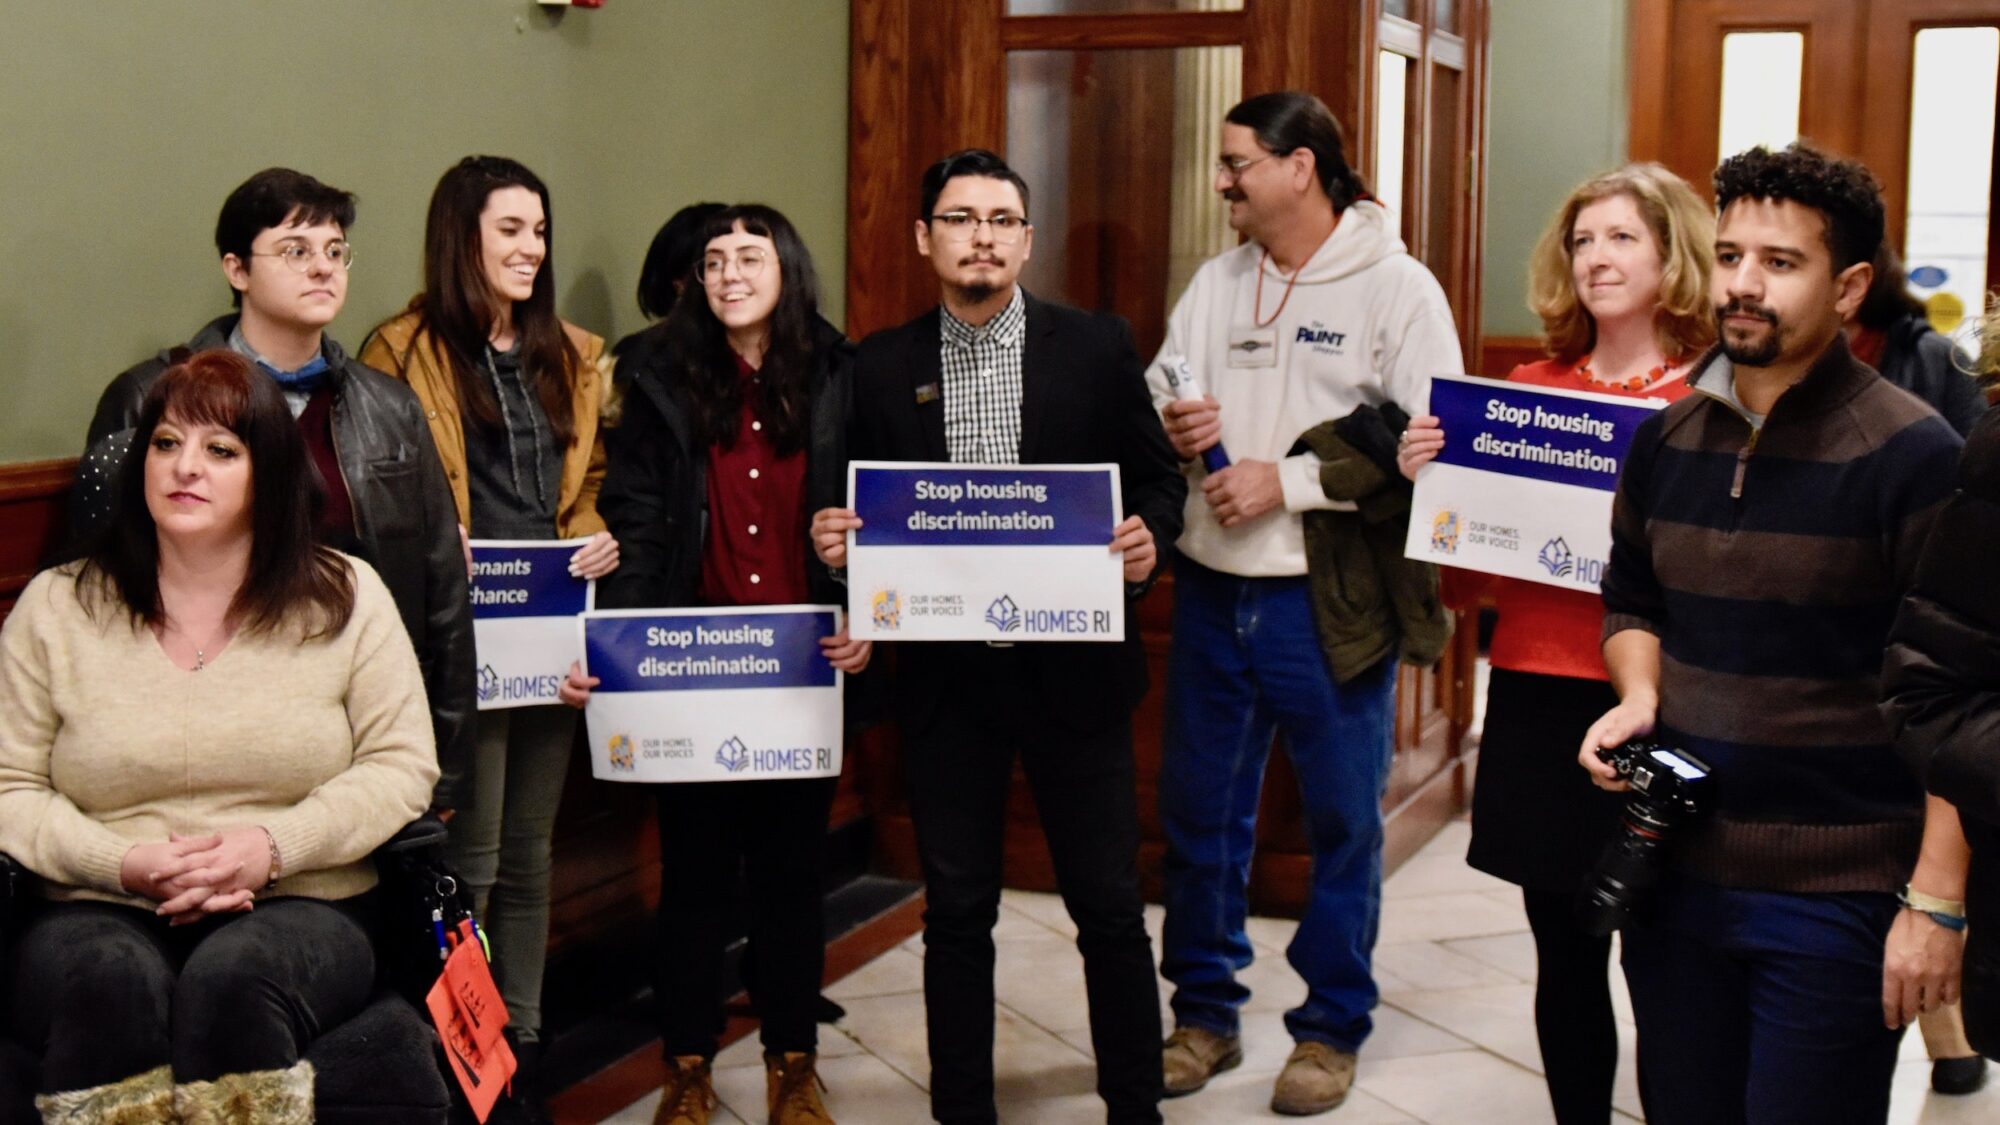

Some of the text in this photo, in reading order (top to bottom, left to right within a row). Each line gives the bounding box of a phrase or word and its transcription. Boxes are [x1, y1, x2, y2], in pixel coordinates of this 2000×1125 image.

[1295, 326, 1346, 346] PAINT
[1485, 399, 1615, 442] Stop housing
[1473, 432, 1617, 474] discrimination
[915, 480, 1048, 502] Stop housing
[907, 511, 1054, 530] discrimination
[1469, 521, 1488, 532] OUR
[1468, 532, 1519, 551] OUR VOICES
[472, 558, 532, 576] enants
[1575, 556, 1605, 584] HO
[910, 595, 929, 605] OUR
[910, 606, 964, 616] OUR VOICES
[1025, 610, 1111, 632] HOMES RI
[647, 624, 775, 649] Stop housing
[638, 656, 780, 677] discrimination
[503, 675, 558, 700] HOMES
[642, 739, 661, 748] OUR
[642, 749, 694, 759] OUR VOICES
[753, 748, 831, 771] HOMES RI
